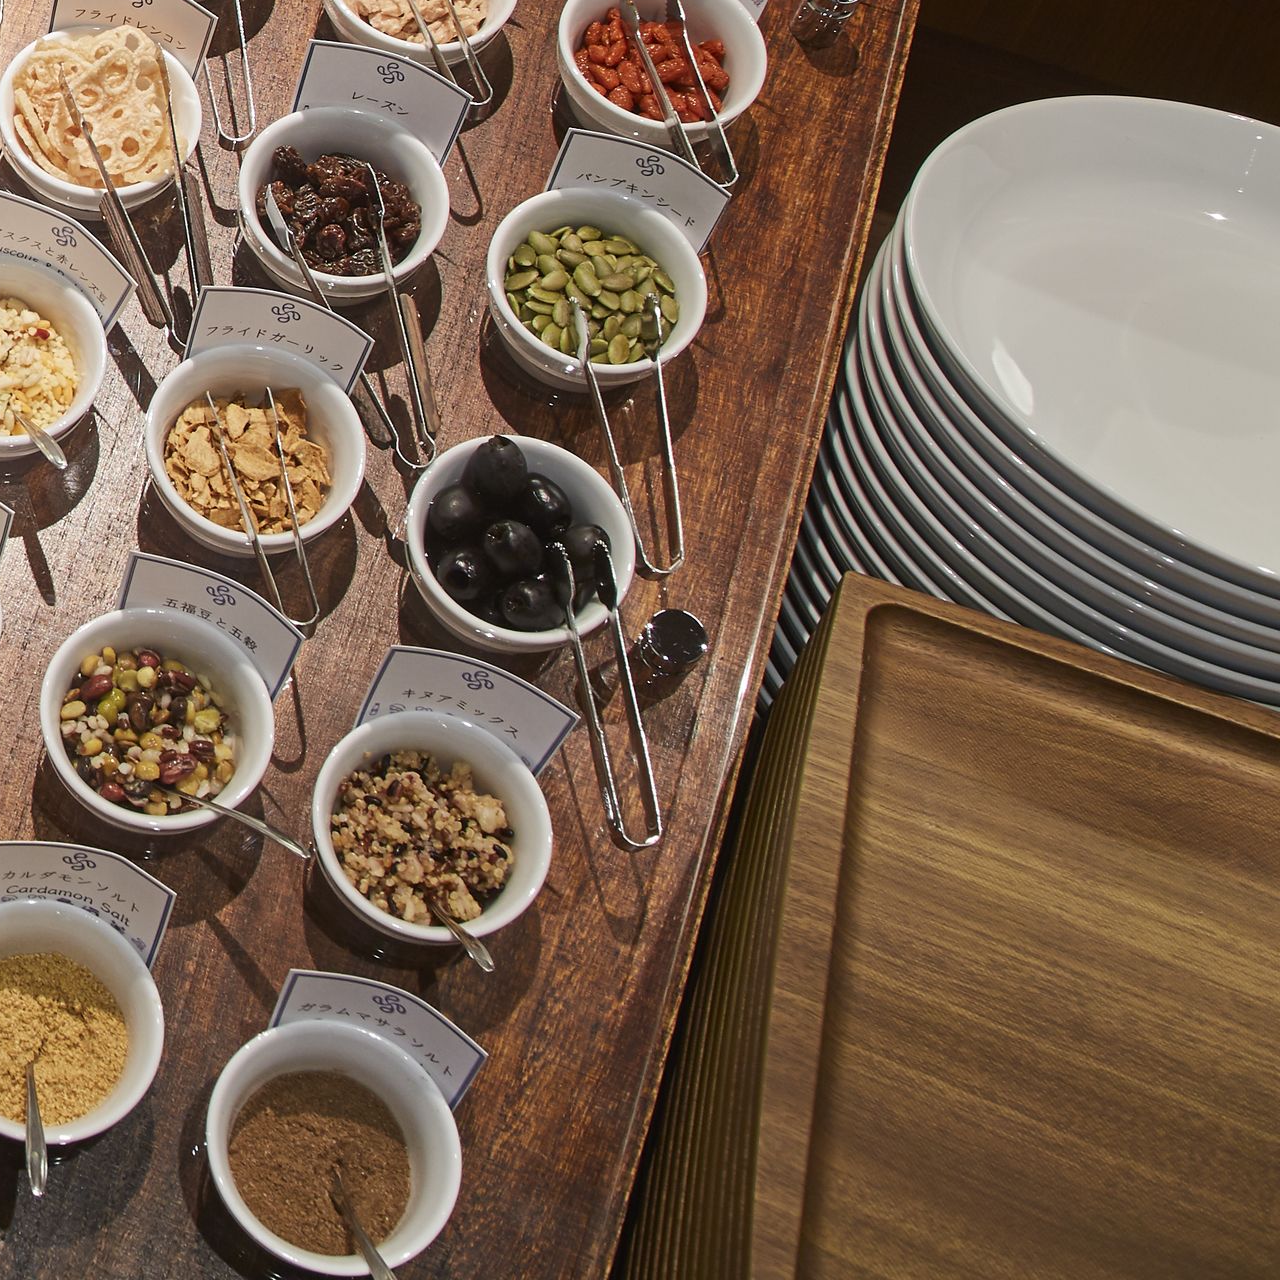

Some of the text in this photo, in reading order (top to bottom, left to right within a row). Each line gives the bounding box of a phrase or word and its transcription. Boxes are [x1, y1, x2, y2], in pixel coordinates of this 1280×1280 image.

[74, 9, 187, 51] フライドレンコン
[352, 91, 410, 116] レーズン
[576, 172, 696, 227] パンプキンシード
[206, 325, 344, 372] フライドガーリック
[402, 688, 521, 740] キヌアミックス
[2, 870, 140, 913] カルダモンソルト
[6, 884, 131, 927] Cardamon Salt
[297, 1001, 453, 1078] ガラムマサラソルト
